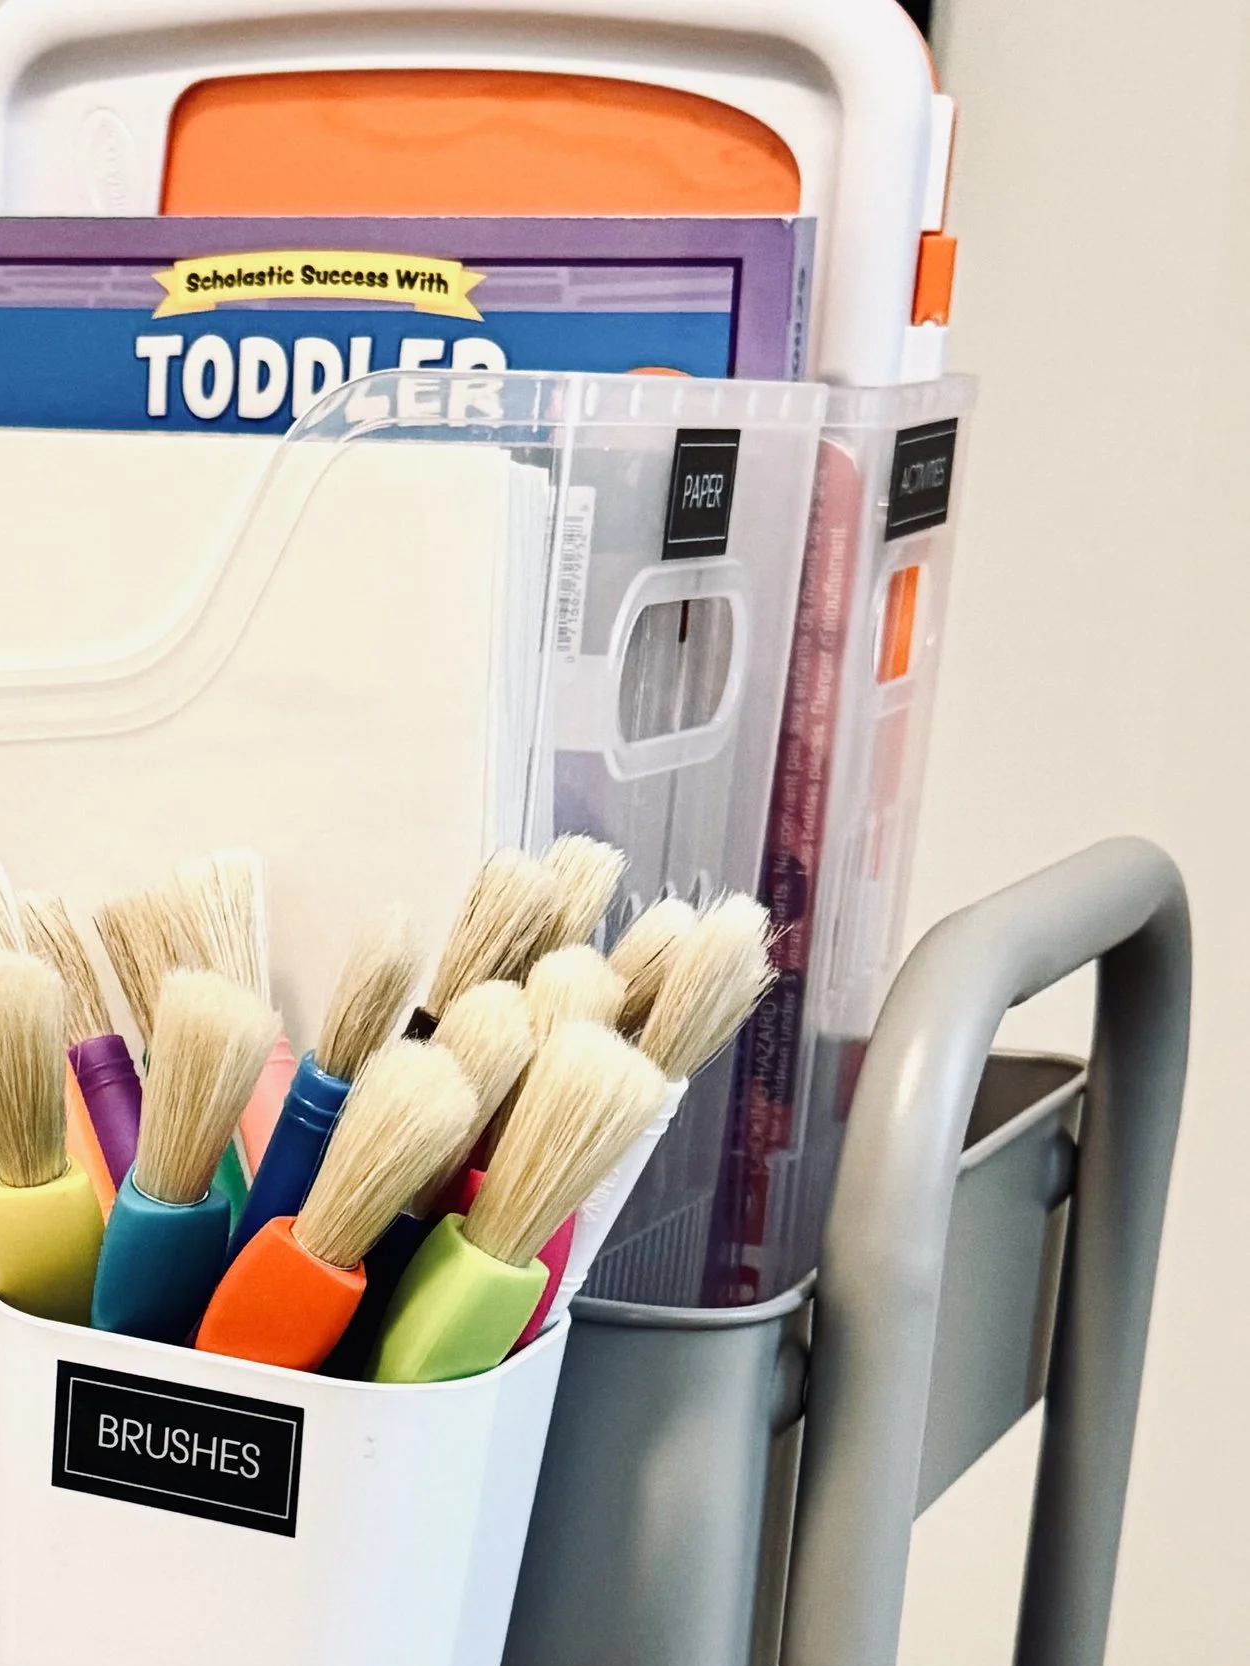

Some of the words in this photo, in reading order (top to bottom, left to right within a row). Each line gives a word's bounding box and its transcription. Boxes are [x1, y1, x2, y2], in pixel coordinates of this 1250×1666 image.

[185, 265, 294, 293] Scholastic
[300, 264, 388, 287] Success
[395, 268, 450, 294] With
[135, 333, 508, 428] TODDLER
[681, 474, 724, 510] PAPER
[791, 635, 812, 700] enfants
[808, 651, 834, 715] Danger
[788, 703, 806, 735] aux
[786, 740, 804, 772] pas
[778, 774, 799, 846] convient
[753, 1001, 778, 1081] HAZARD
[778, 991, 796, 1042] under
[98, 1413, 261, 1479] BRUSHES
